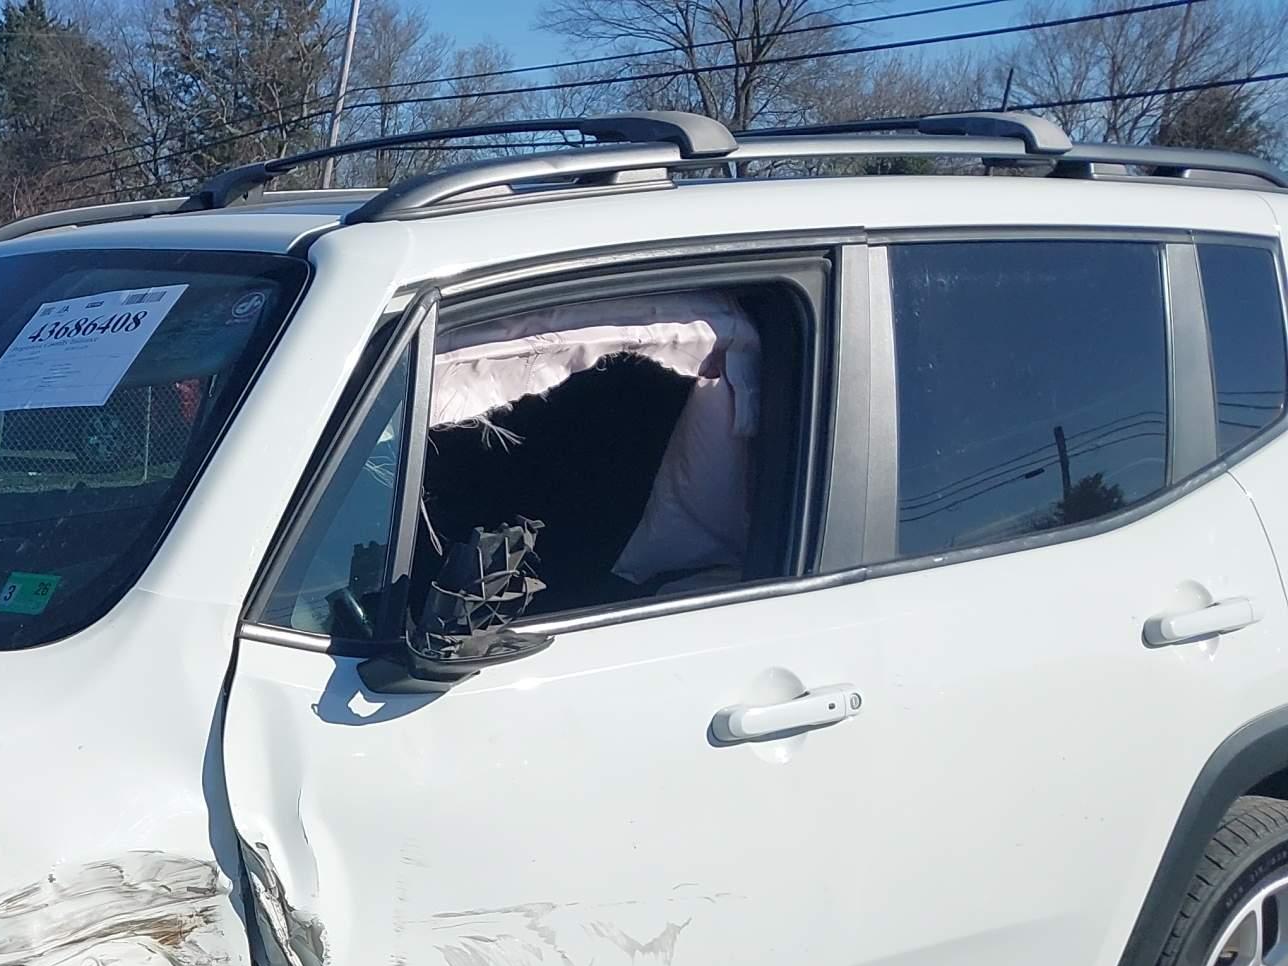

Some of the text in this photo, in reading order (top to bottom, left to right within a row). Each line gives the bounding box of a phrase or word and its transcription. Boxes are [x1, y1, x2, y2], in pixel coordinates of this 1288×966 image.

[28, 310, 148, 343] 43686408
[4, 582, 52, 601] 3 26
